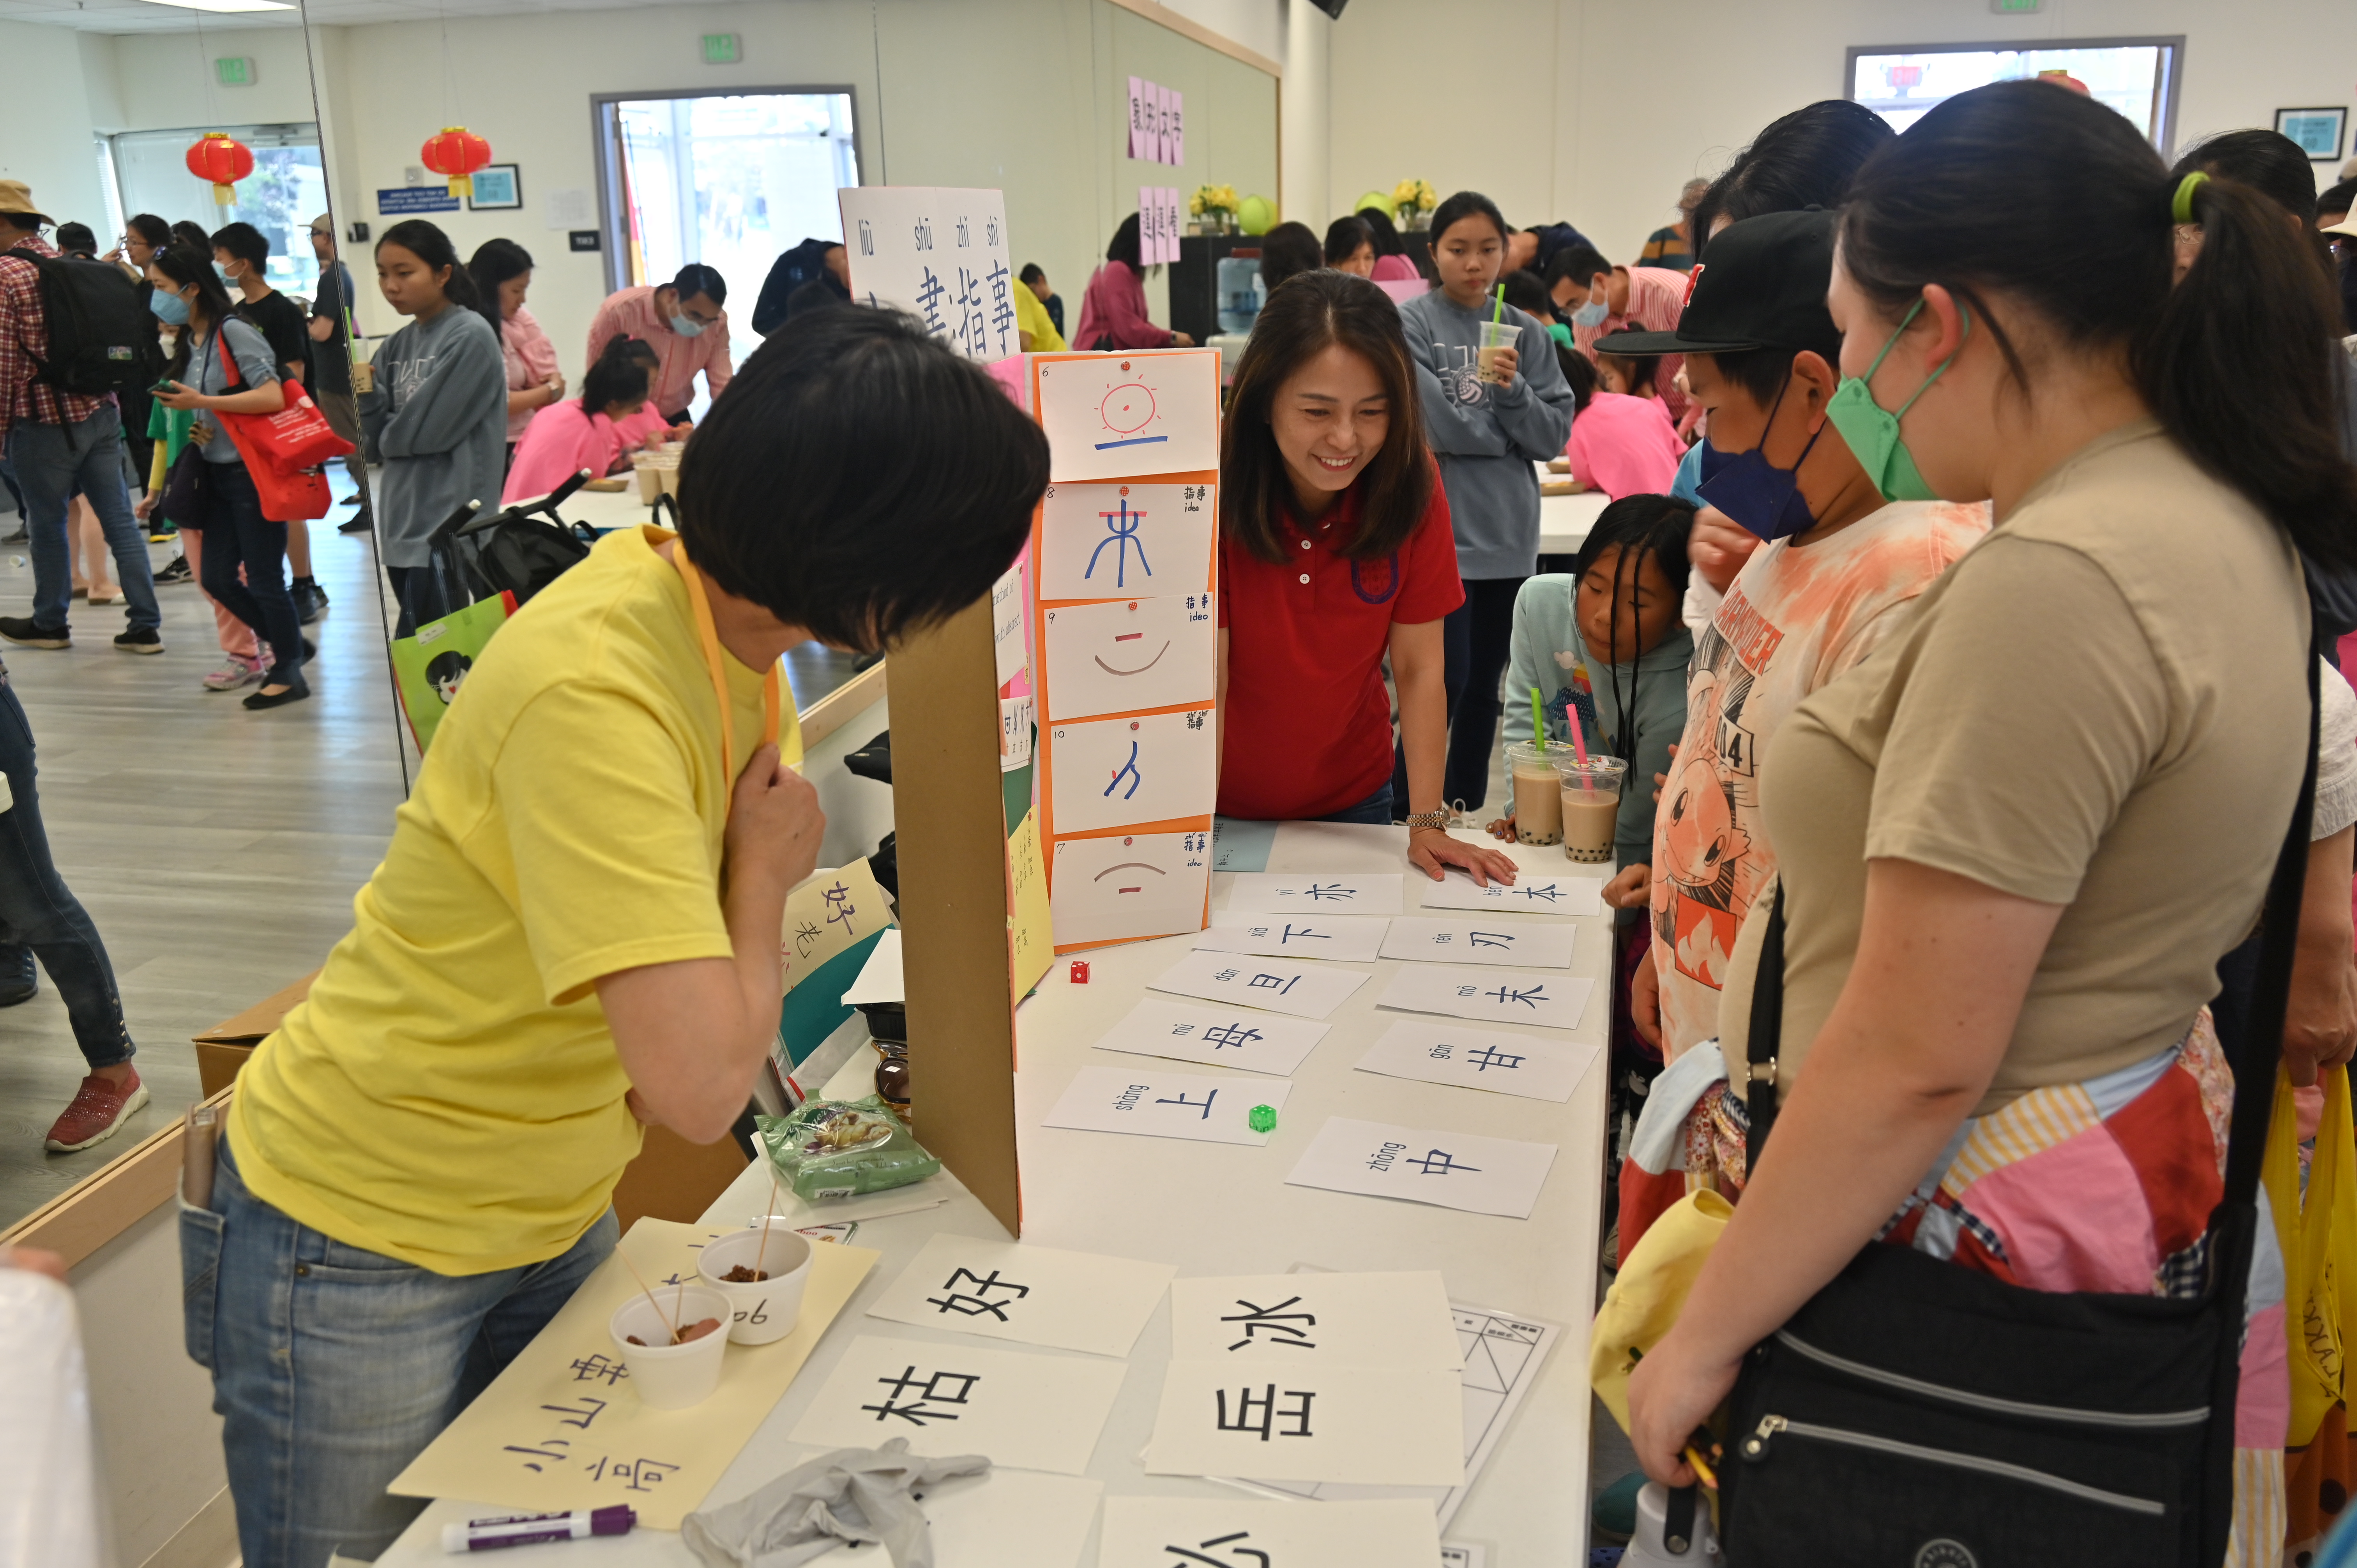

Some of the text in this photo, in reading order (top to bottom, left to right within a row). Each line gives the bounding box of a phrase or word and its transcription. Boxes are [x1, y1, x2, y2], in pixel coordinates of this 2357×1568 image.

[859, 215, 998, 256] liù shū zhǐ shì
[1041, 366, 1050, 377] 6
[1047, 487, 1055, 498] 8
[1184, 485, 1206, 501] 指事
[1009, 578, 1014, 593] of
[1186, 593, 1209, 610] 指事
[1048, 612, 1055, 625] 9
[995, 612, 1021, 645] with abstract
[1187, 716, 1204, 730] 指事
[1054, 730, 1065, 739] 10
[1057, 843, 1065, 854] 7
[1184, 839, 1205, 853] 指事
[1304, 883, 1357, 902] 亦
[1512, 883, 1568, 903] 本
[821, 880, 856, 936] 好
[1248, 927, 1269, 938] xià
[1281, 923, 1332, 945] 下
[1432, 932, 1452, 944] rèn
[1470, 931, 1516, 950] 刃
[1213, 968, 1240, 982] dàn
[1247, 973, 1302, 995] 旦
[1456, 985, 1477, 997] mò
[1485, 984, 1550, 1009] 末
[1171, 1023, 1195, 1036] mǔ
[1201, 1022, 1264, 1050] 母
[1429, 1043, 1454, 1060] gān
[1467, 1045, 1527, 1072] 甘
[1112, 1084, 1150, 1111] shàng
[1155, 1089, 1218, 1120] 上
[1366, 1141, 1407, 1172] zhōng
[1406, 1148, 1482, 1174] 中
[926, 1267, 1030, 1322] 好
[1221, 1296, 1316, 1351] 冰
[861, 1365, 981, 1427] 枯
[1216, 1383, 1316, 1442] 岳
